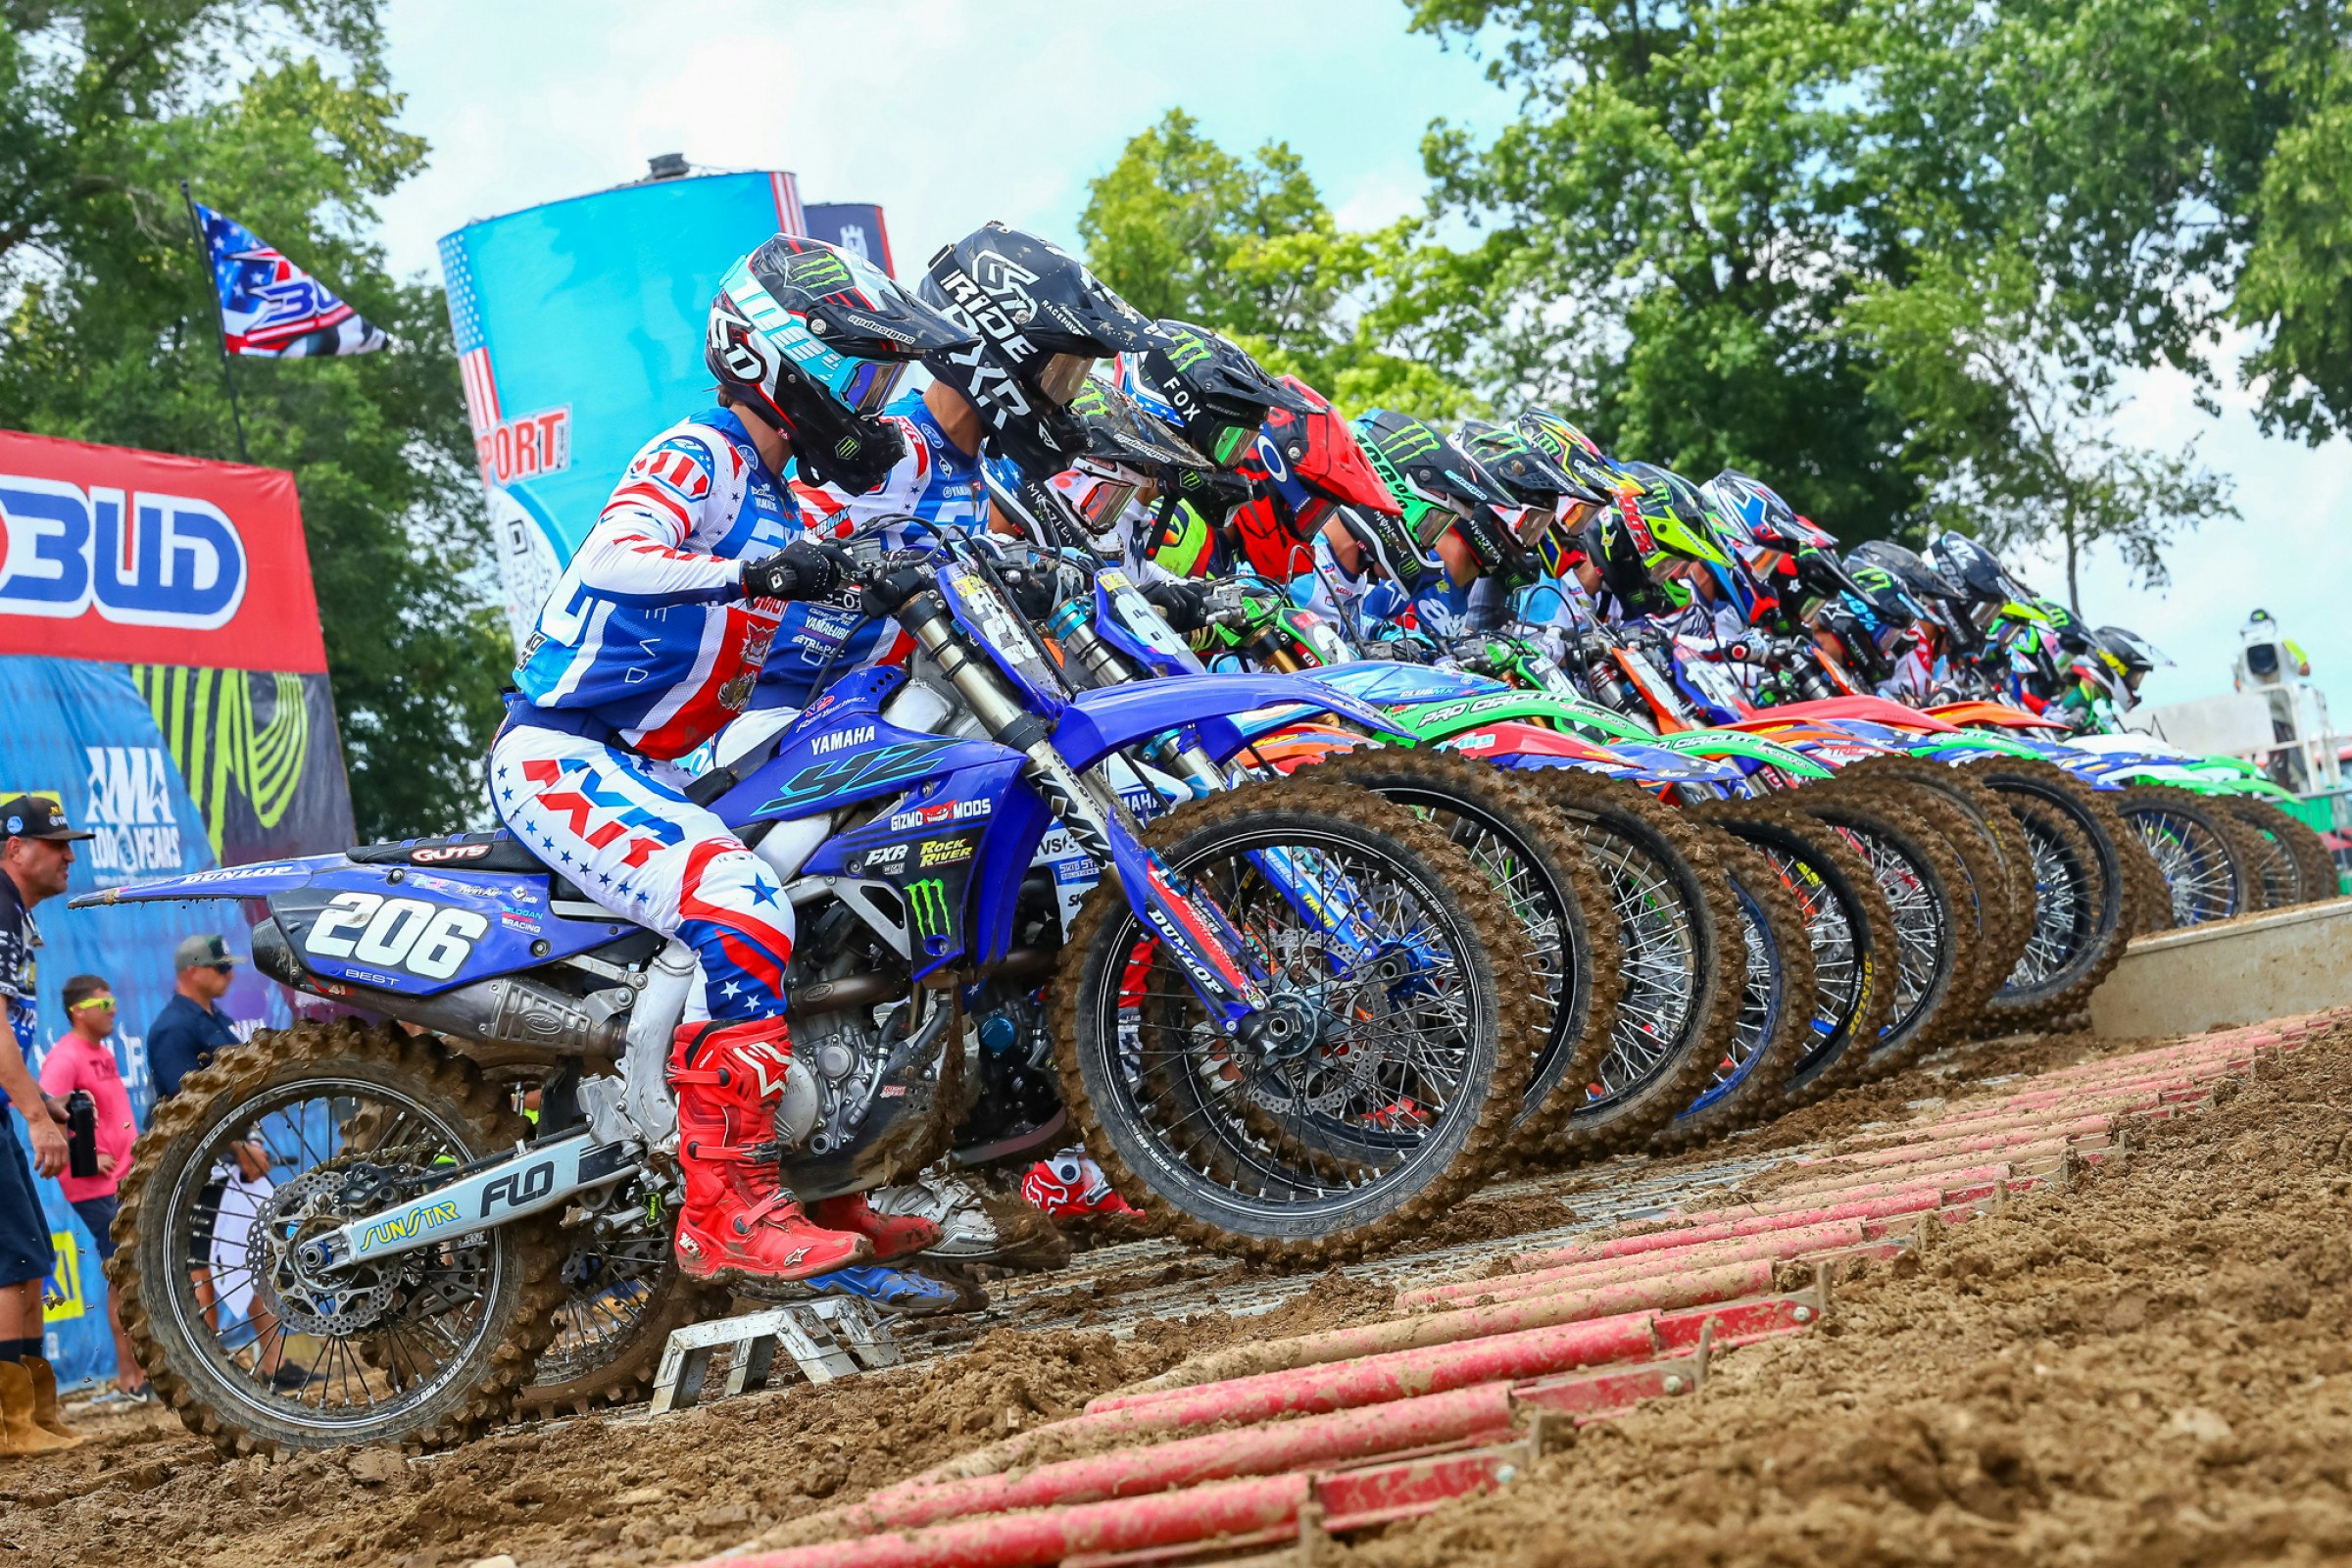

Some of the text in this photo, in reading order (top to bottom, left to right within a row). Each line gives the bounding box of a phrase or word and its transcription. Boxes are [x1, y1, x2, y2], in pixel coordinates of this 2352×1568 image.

[1163, 376, 1201, 422] FOX
[1418, 690, 1576, 729] PRO CIRCUIT
[810, 725, 875, 756] YAMAHA
[891, 811, 923, 831] GIZMO
[953, 798, 992, 820] MODS
[133, 826, 182, 869] YEARS
[410, 844, 491, 862] GUTS
[864, 843, 909, 867] FXR
[183, 866, 293, 885] DUNLOP
[305, 891, 489, 980] 206
[1147, 908, 1225, 994] DUNLOP
[345, 968, 401, 986] BEST
[480, 1160, 555, 1219] FLO
[360, 1200, 462, 1253] SUNSTAR
